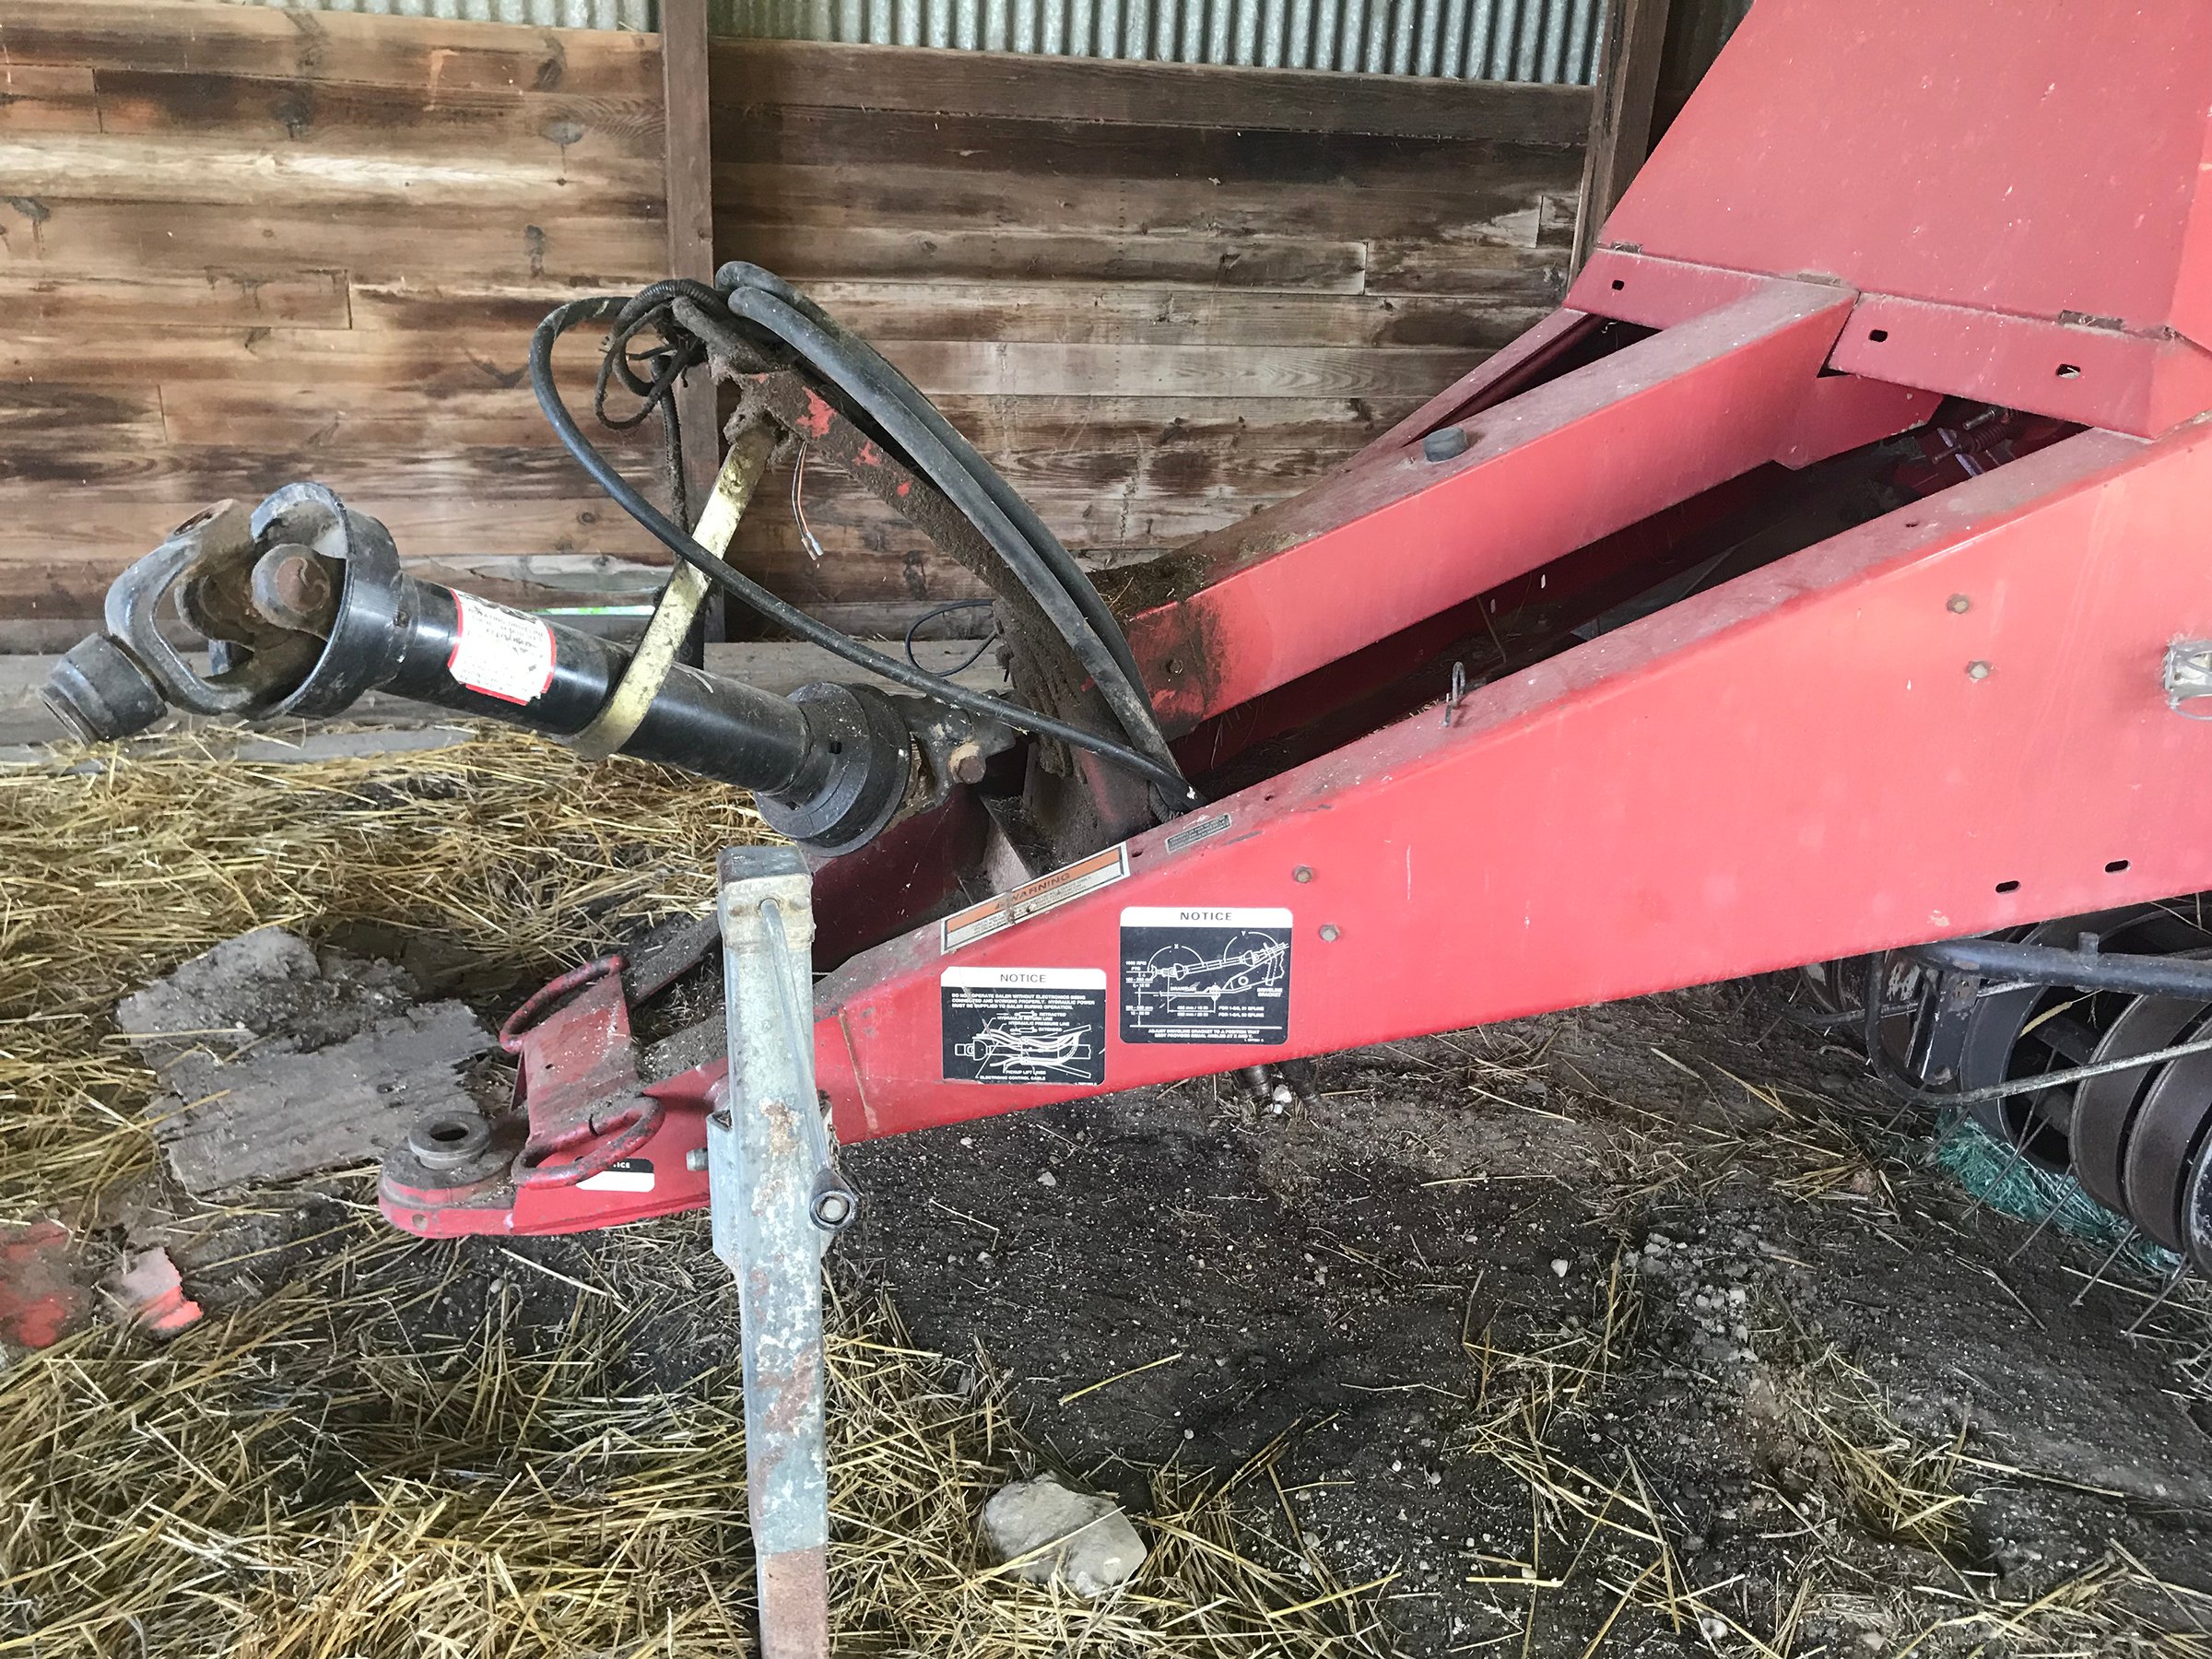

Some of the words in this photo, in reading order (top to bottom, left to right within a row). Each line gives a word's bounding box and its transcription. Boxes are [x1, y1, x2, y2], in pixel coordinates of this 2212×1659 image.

[1012, 872, 1071, 901] WARNING
[1180, 912, 1232, 921] NOTICE
[1000, 973, 1046, 983] NOTICE
